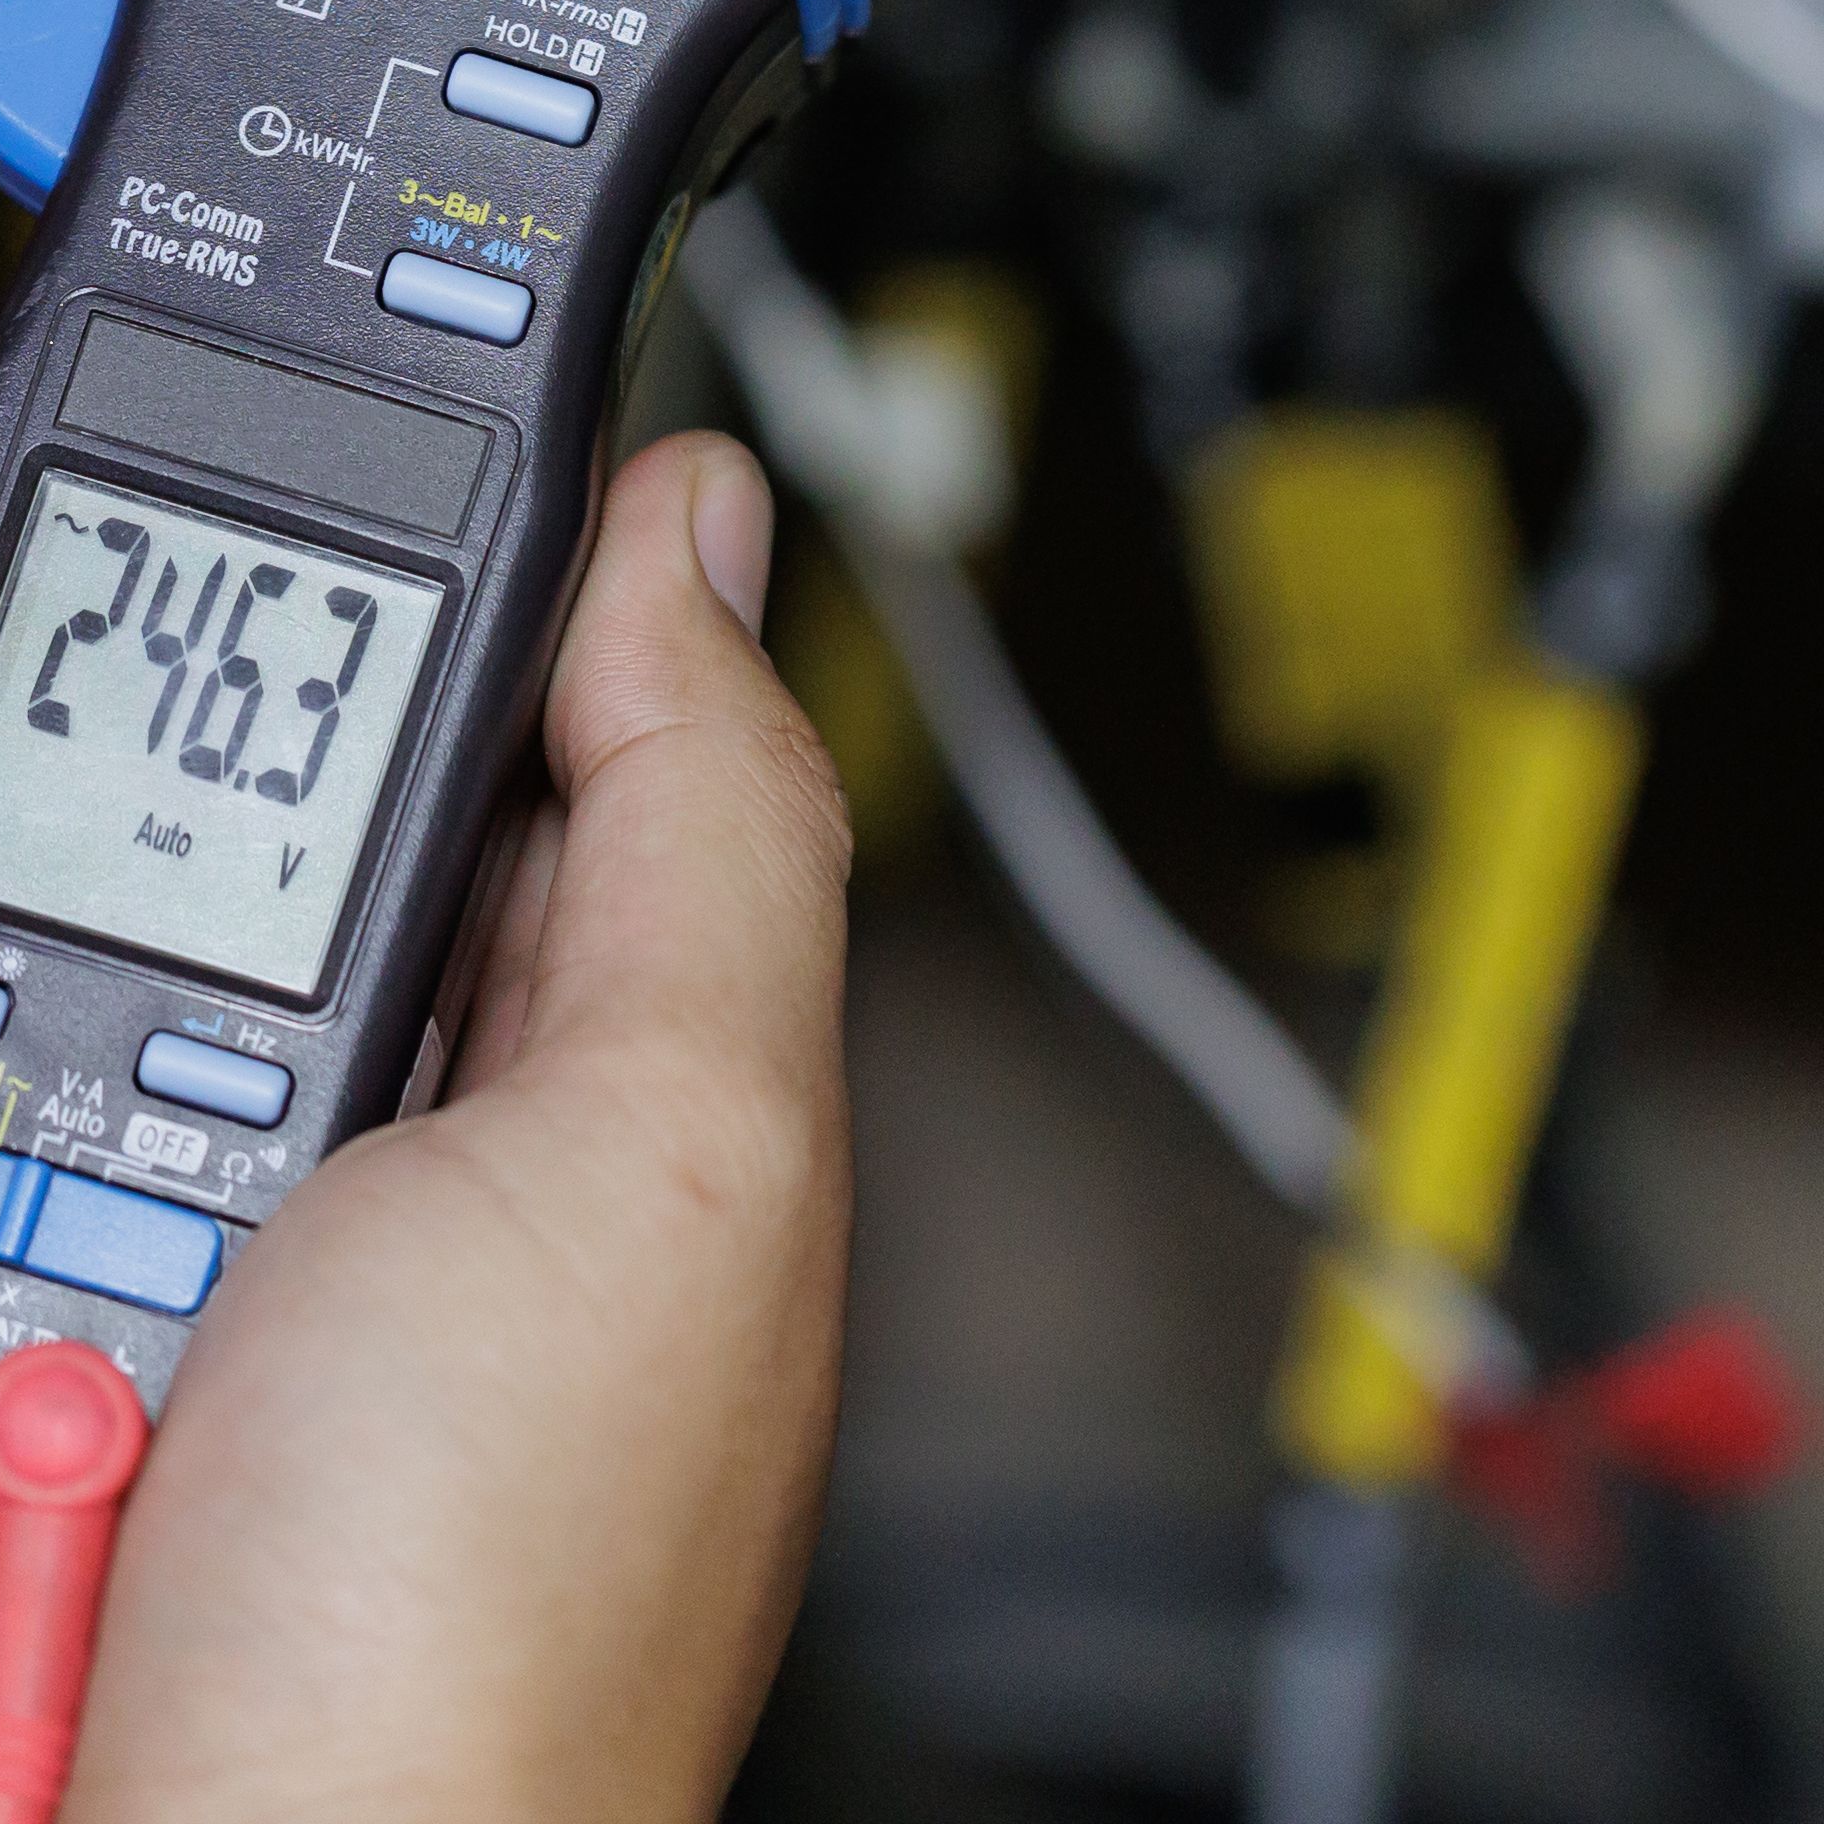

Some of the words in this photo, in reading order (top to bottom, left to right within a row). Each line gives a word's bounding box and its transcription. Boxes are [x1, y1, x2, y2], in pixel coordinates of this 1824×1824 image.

[485, 14, 569, 60] HOLD
[119, 176, 264, 244] PC-Comm
[110, 218, 259, 287] True-RMS
[410, 216, 462, 250] 3W
[480, 239, 534, 272] 4W
[134, 812, 193, 859] Auto
[279, 841, 307, 890] V
[237, 1022, 278, 1057] Hz
[37, 1094, 106, 1138] Auto
[138, 1124, 196, 1164] OFF
